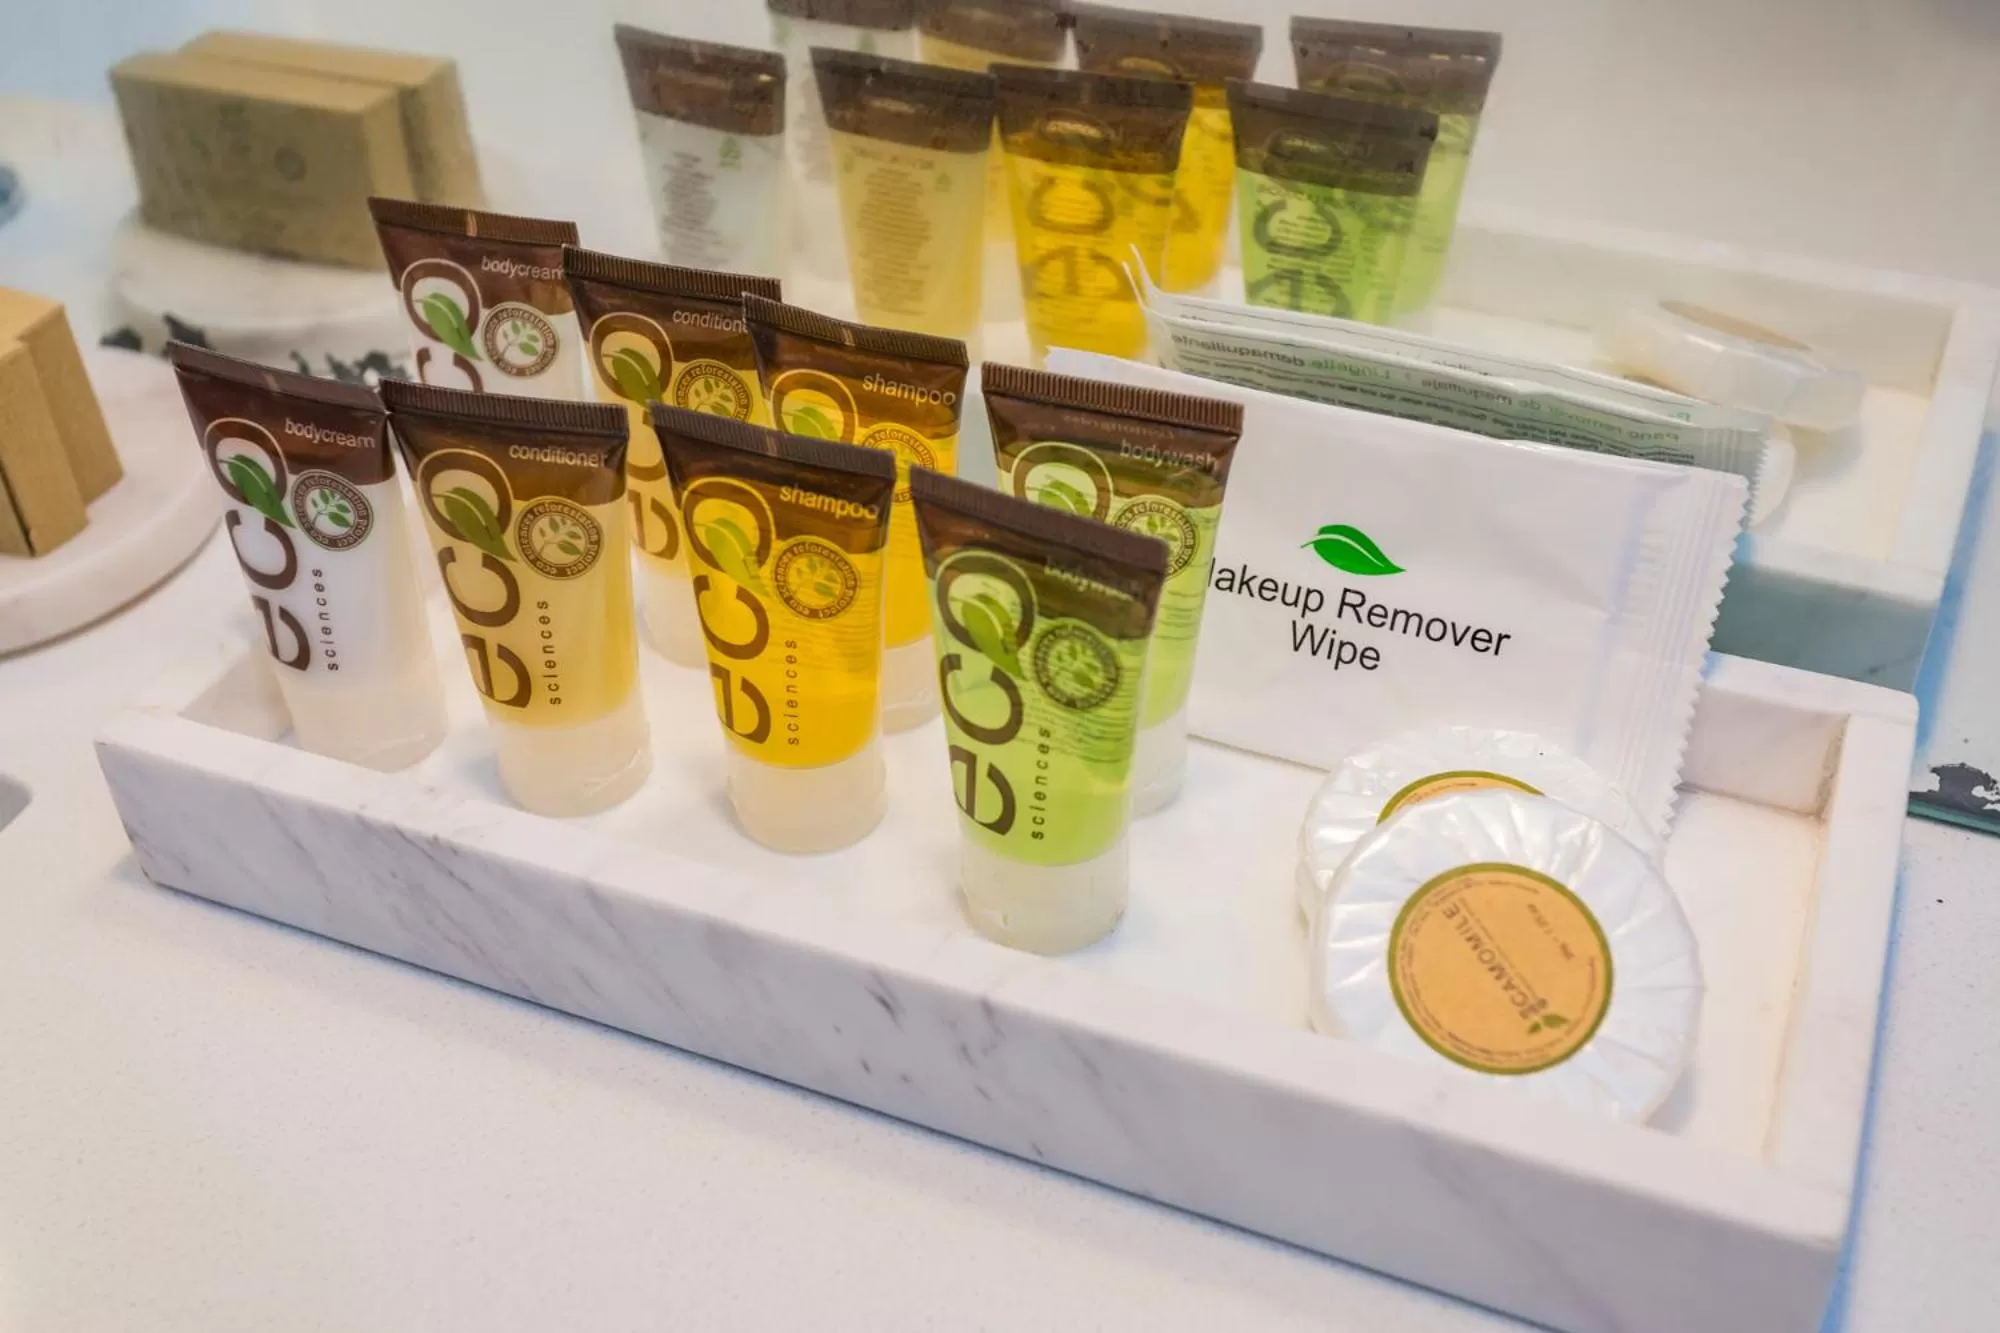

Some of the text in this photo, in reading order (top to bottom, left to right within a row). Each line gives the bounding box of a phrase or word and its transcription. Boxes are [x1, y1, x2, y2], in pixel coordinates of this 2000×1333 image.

[284, 417, 375, 449] bodycream
[862, 373, 956, 408] shampoo
[509, 444, 608, 469] conditioner
[780, 484, 880, 521] shampoo
[1120, 440, 1218, 473] bodywash
[204, 417, 311, 672] eco
[417, 448, 532, 708] eco
[529, 502, 599, 540] reforestation
[565, 543, 599, 575] project
[312, 568, 339, 672] sciences
[537, 600, 562, 706] sciences
[682, 477, 776, 744] eco
[1207, 557, 1512, 656] akeup Remover
[1291, 619, 1381, 671] Wipe
[784, 640, 799, 746] sciences
[936, 549, 1038, 837] eco
[1029, 726, 1051, 840] sciences
[1442, 902, 1533, 1012] CAMOMILE
